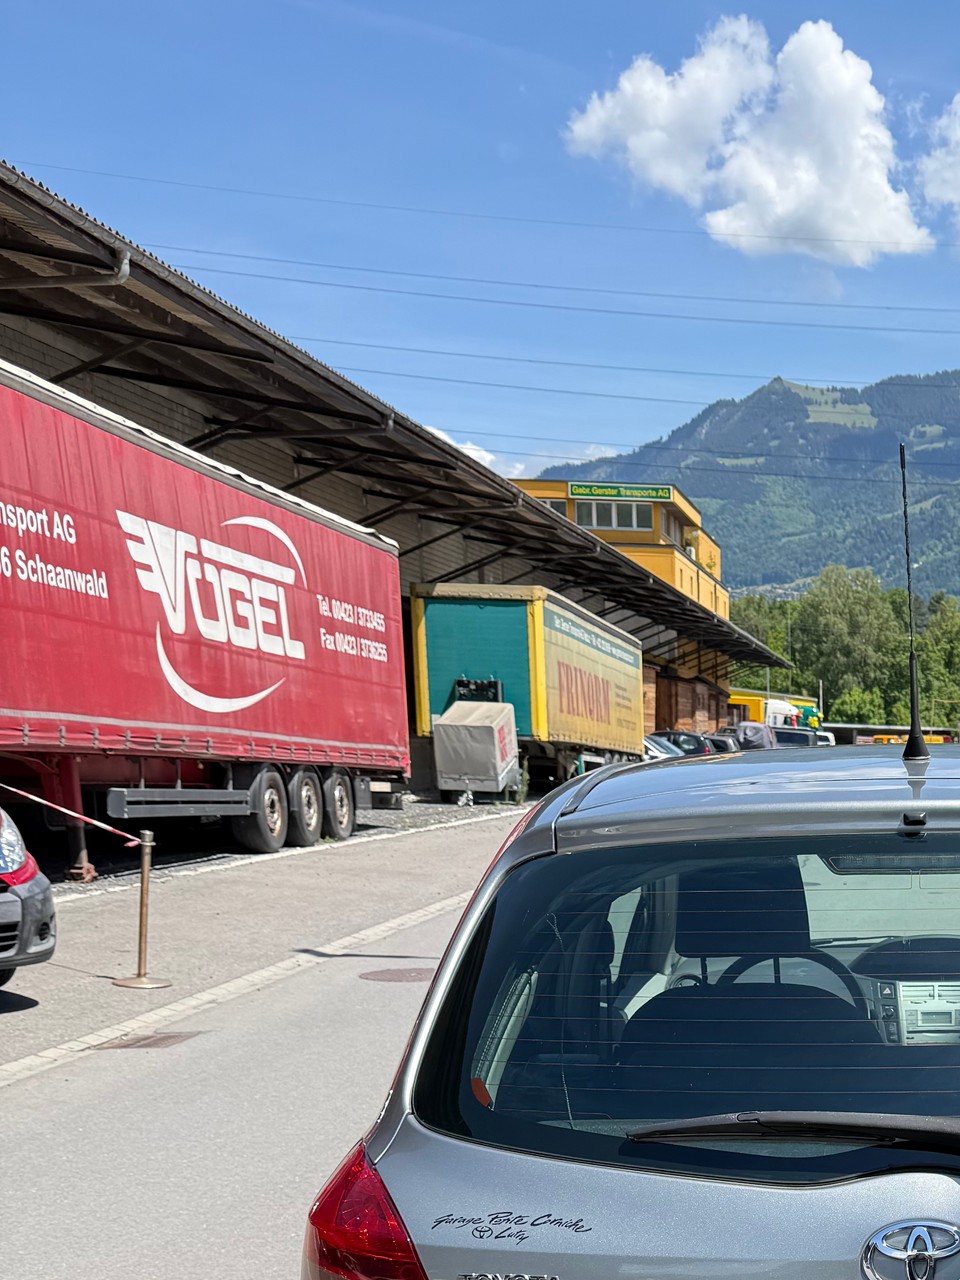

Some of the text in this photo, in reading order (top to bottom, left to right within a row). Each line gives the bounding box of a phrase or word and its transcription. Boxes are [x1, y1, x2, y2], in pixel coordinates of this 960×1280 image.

[657, 489, 669, 498] AG
[53, 510, 77, 545] AG
[15, 548, 109, 599] Schaanwald
[316, 593, 332, 617] Tel.
[320, 627, 336, 651] Fax
[431, 1213, 485, 1230] Garage
[530, 1213, 592, 1233] Corniche
